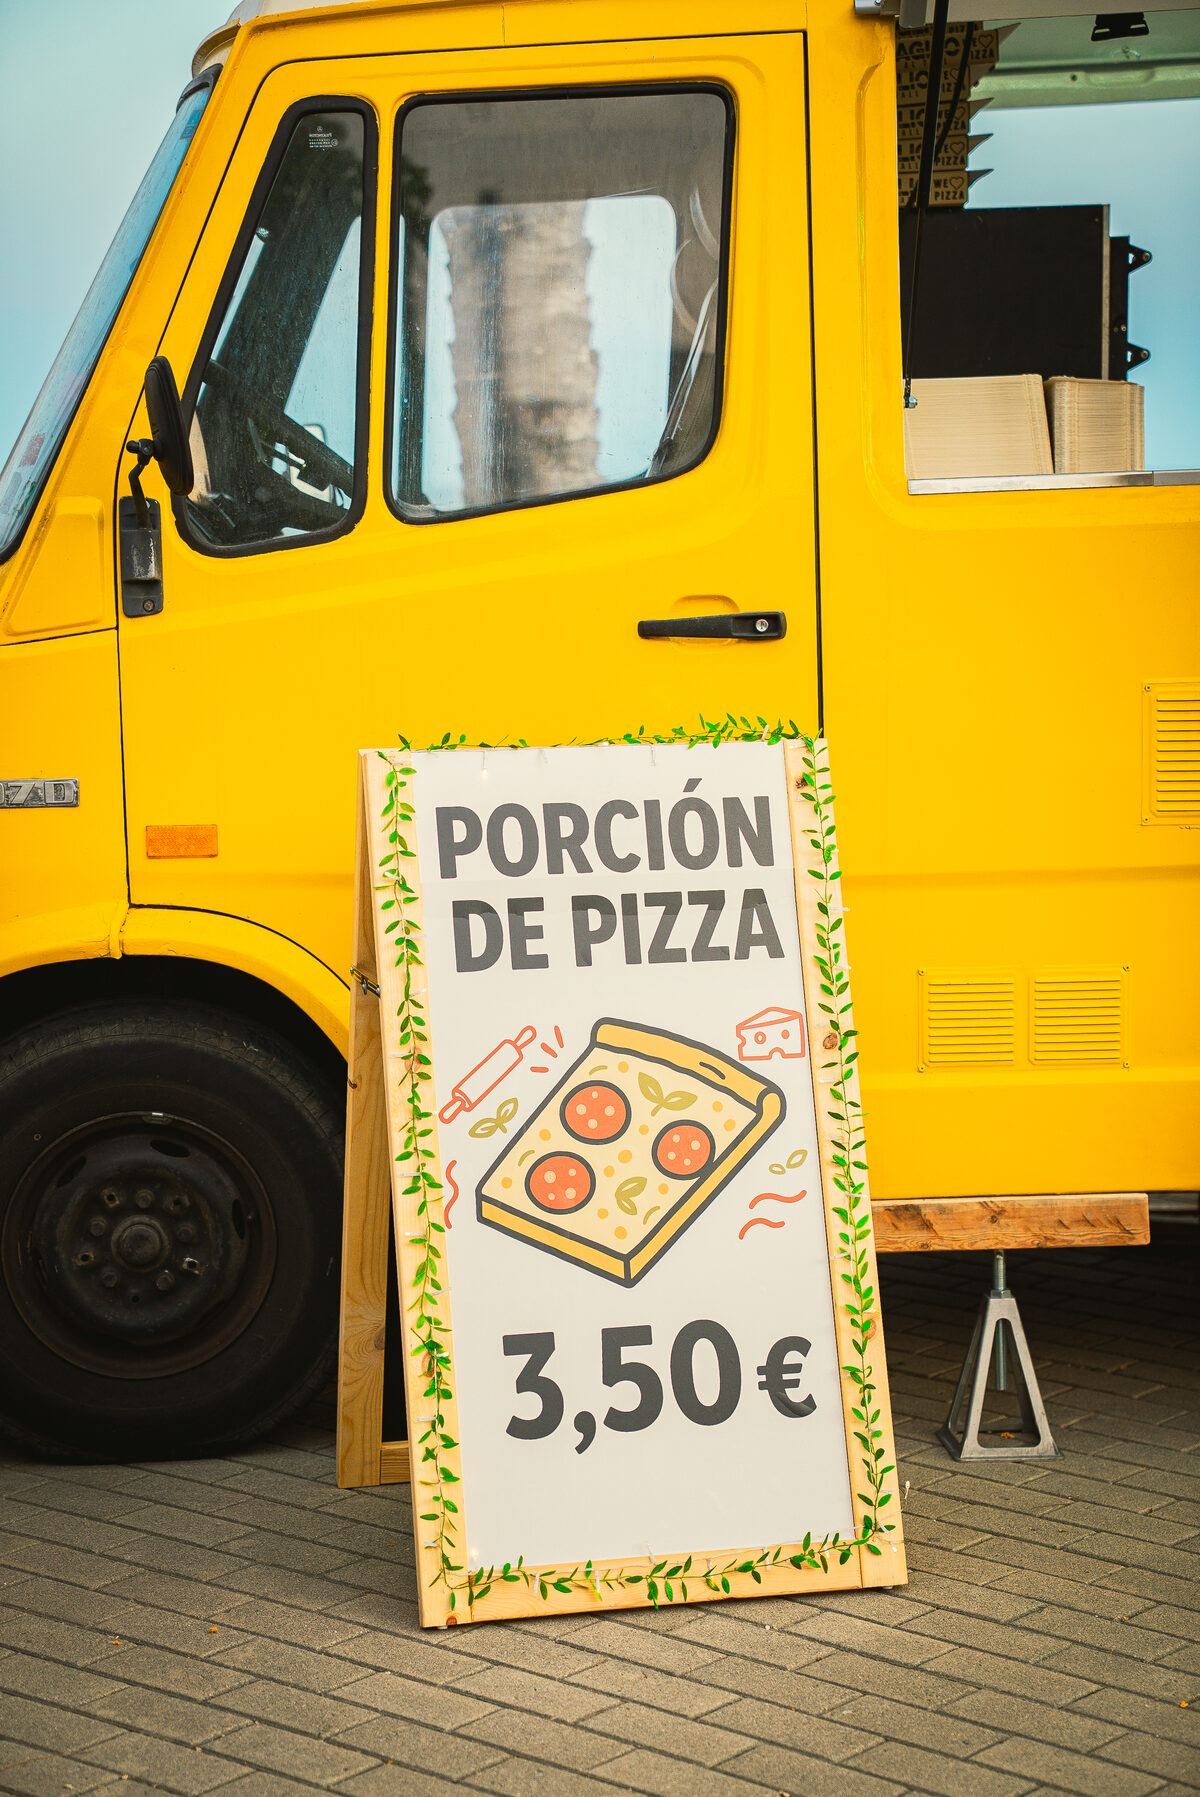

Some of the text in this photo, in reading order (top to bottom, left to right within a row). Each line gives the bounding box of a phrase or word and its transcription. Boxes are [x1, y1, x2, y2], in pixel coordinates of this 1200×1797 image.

[934, 190, 965, 201] PIZZA
[0, 781, 75, 804] 7D
[435, 778, 775, 879] PORCIÓN
[452, 888, 785, 973] DE PIZZA
